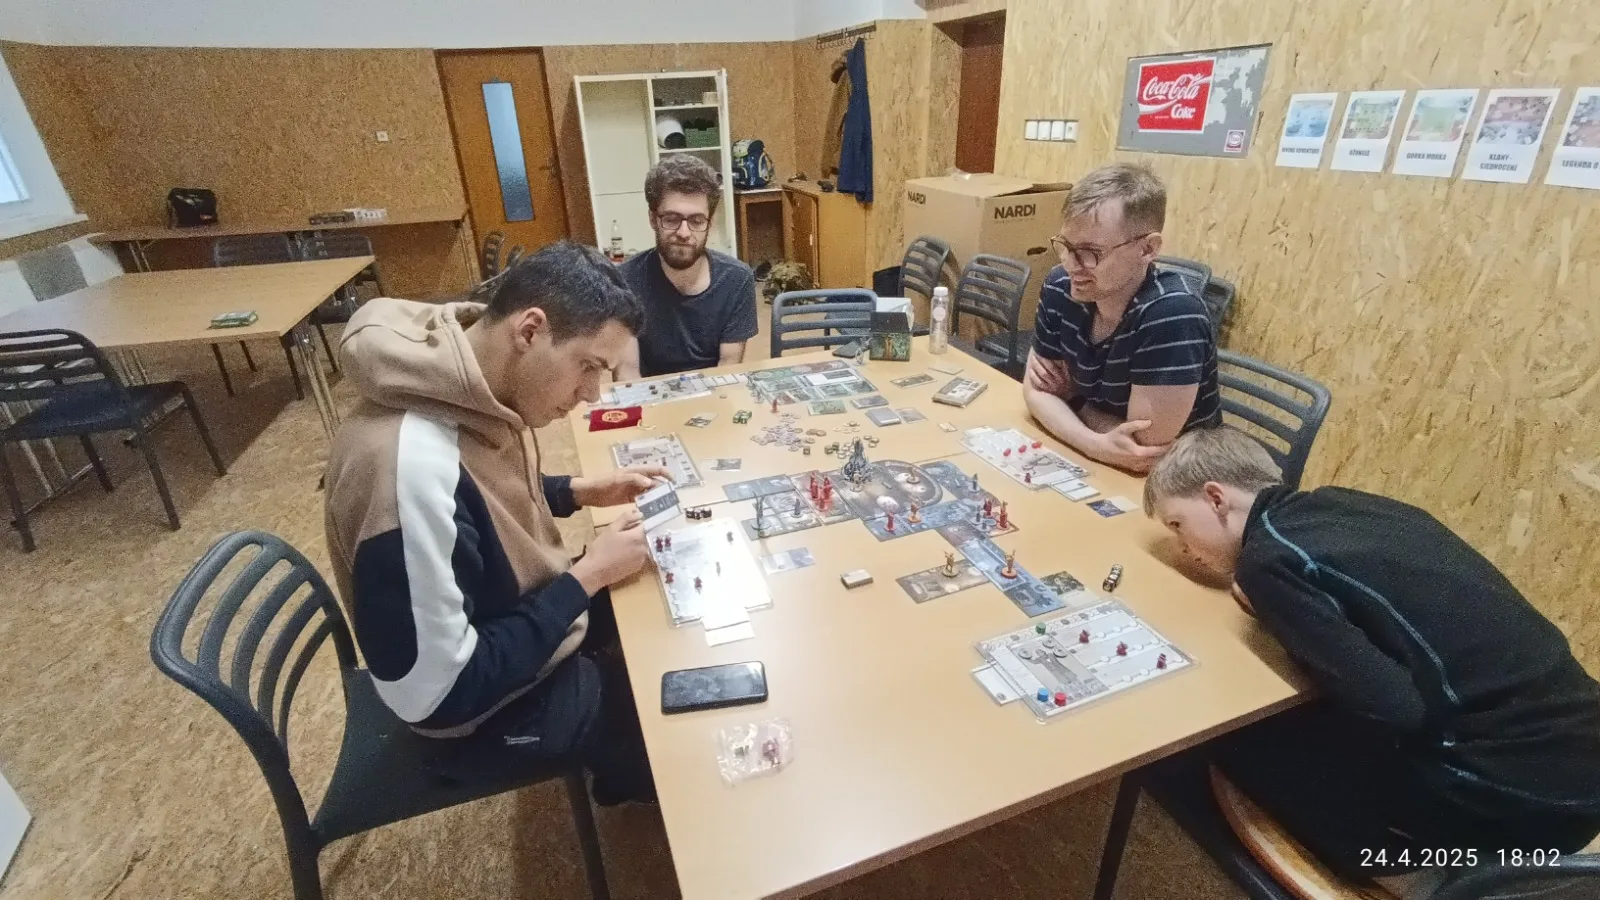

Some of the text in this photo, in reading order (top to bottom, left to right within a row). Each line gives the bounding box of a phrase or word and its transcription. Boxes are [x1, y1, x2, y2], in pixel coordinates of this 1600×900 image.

[1171, 104, 1196, 119] Coke
[907, 191, 926, 205] NARDI
[994, 204, 1036, 219] NARDI
